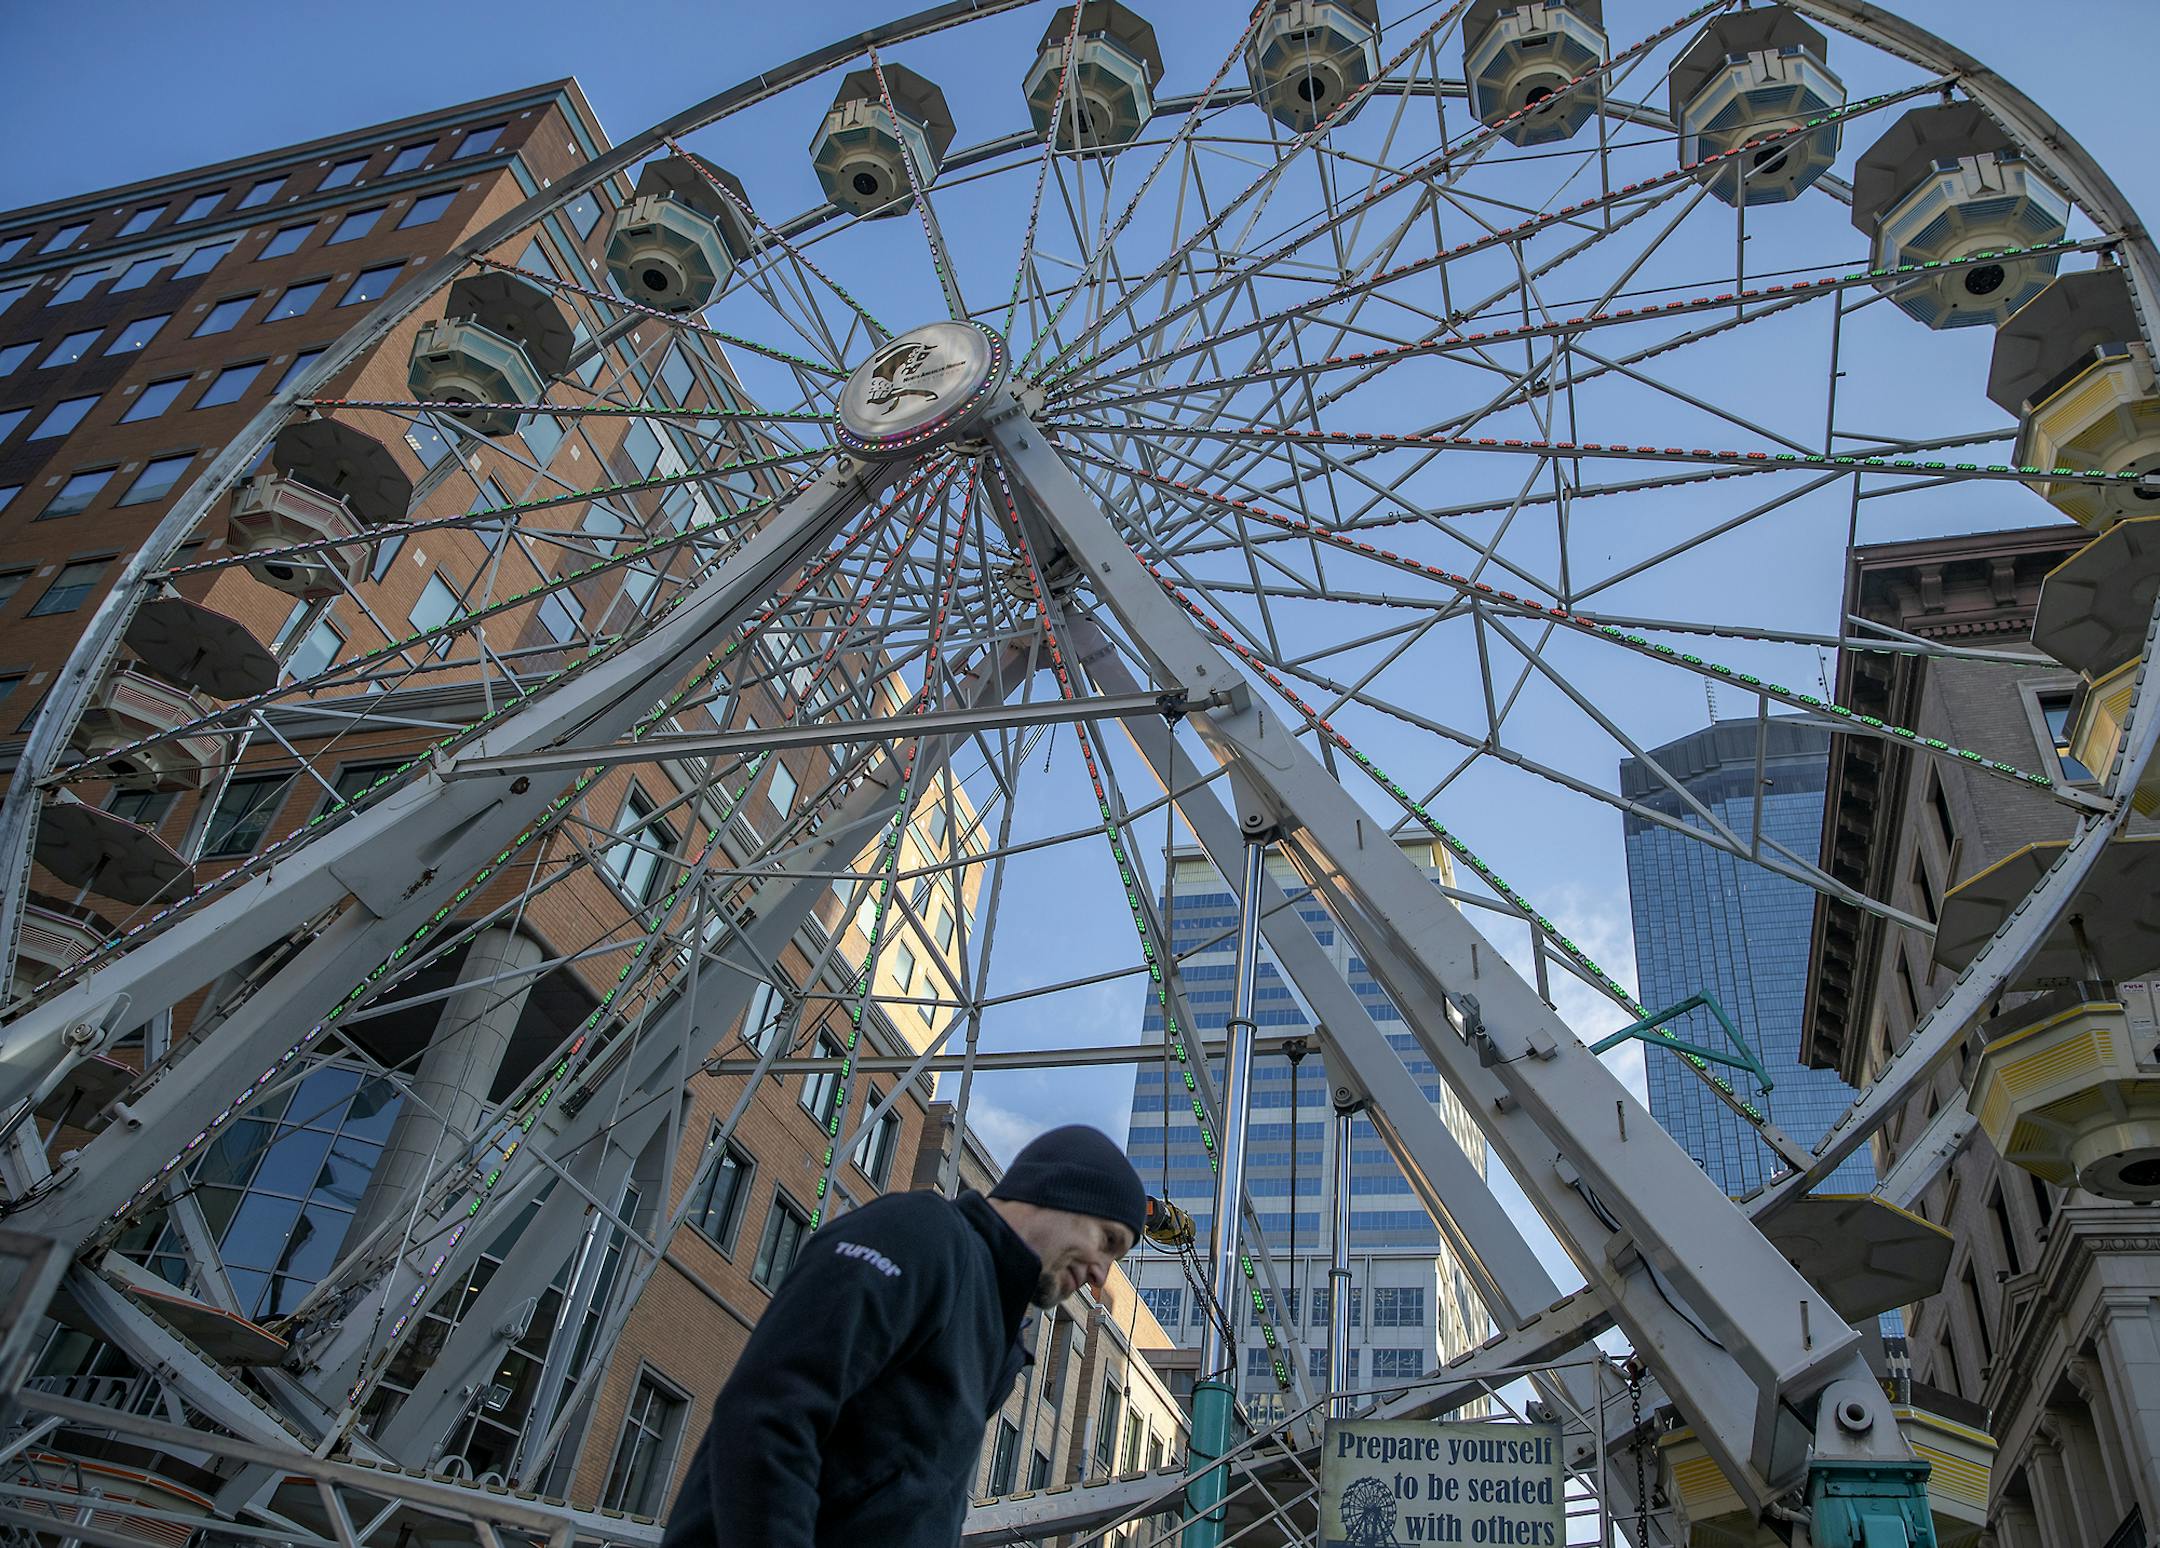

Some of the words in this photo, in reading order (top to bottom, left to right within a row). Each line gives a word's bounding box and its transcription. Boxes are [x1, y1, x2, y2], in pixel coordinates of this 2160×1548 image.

[835, 1241, 903, 1277] Turner
[1337, 1431, 1439, 1464] Prepare
[1448, 1437, 1553, 1465] yourself
[1394, 1472, 1418, 1500] to
[1428, 1473, 1459, 1502] be
[1468, 1476, 1554, 1505] seated
[1405, 1513, 1462, 1543] with
[1471, 1516, 1555, 1546] others
